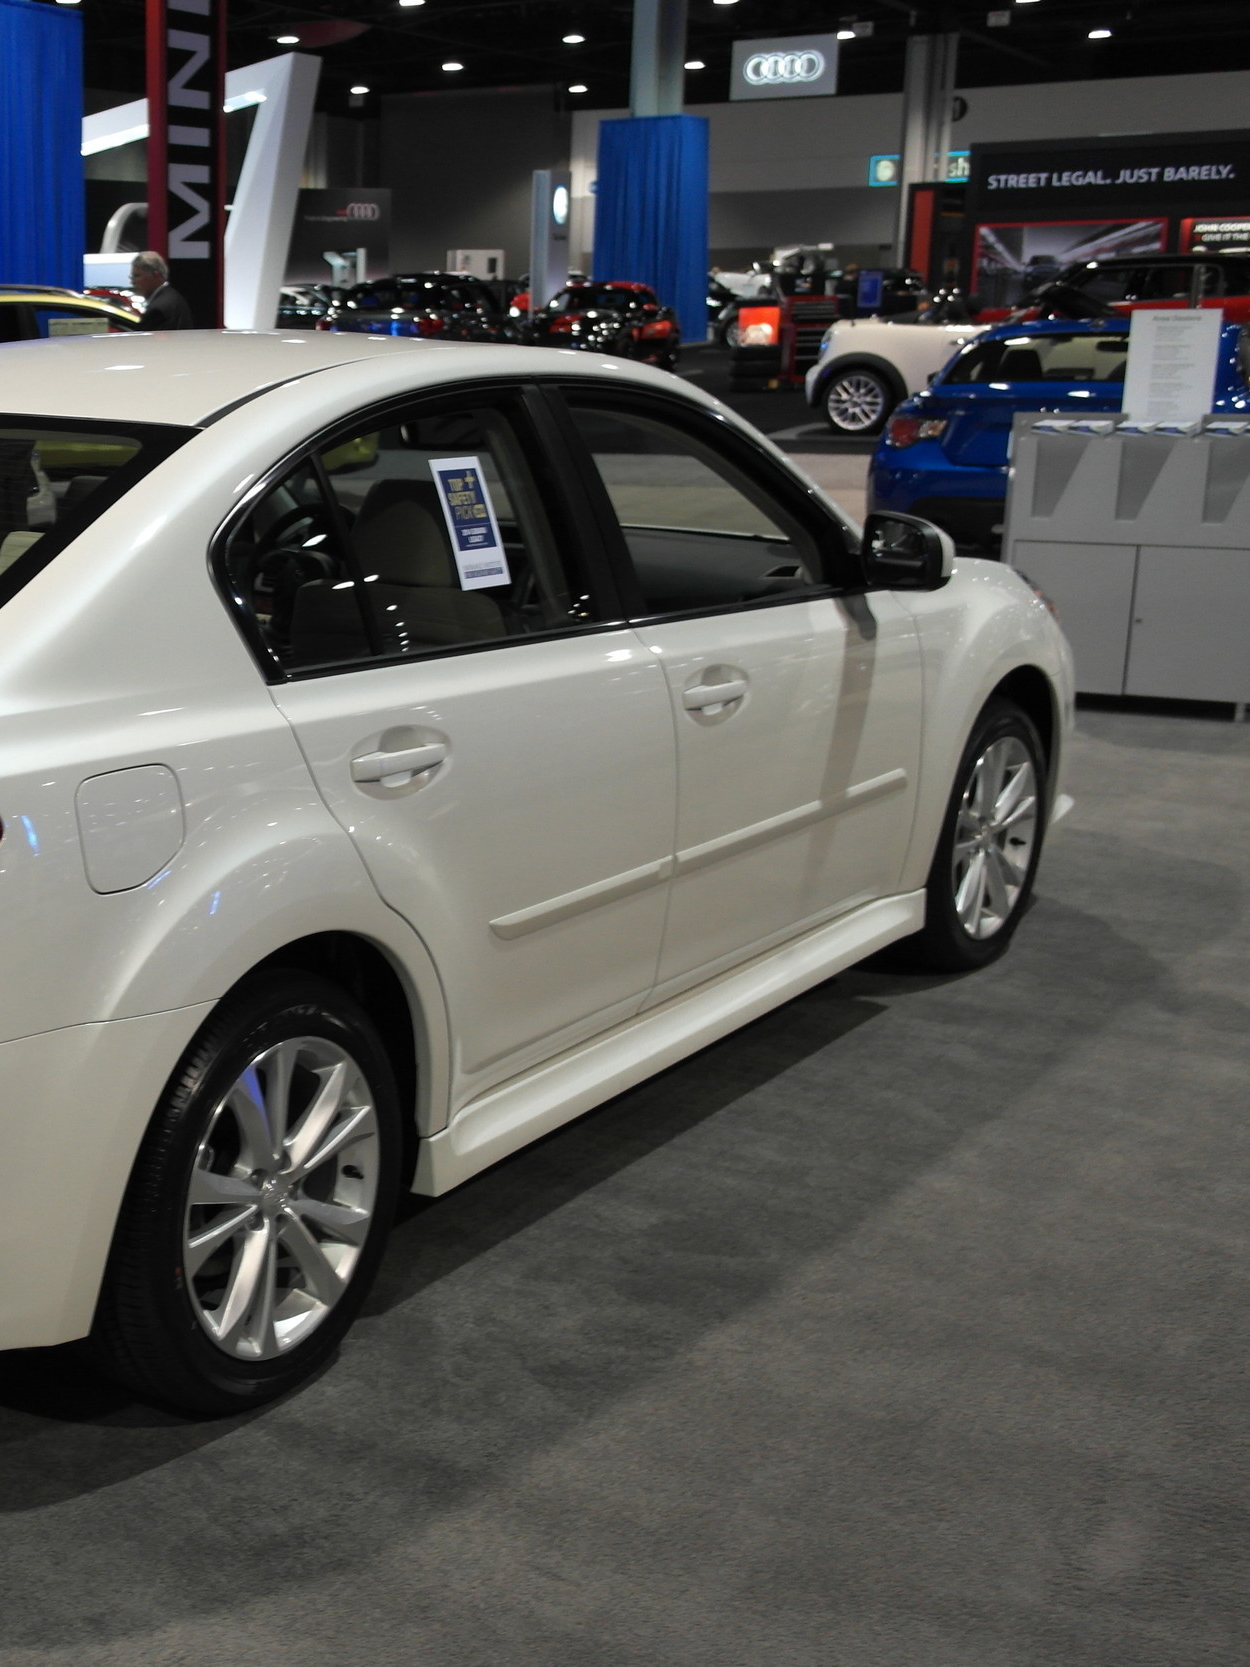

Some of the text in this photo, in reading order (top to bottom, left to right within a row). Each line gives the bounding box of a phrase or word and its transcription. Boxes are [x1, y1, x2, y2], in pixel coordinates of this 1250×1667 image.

[168, 0, 210, 259] MINI
[987, 164, 1236, 190] STREET LEGAL. JUST BARELY.
